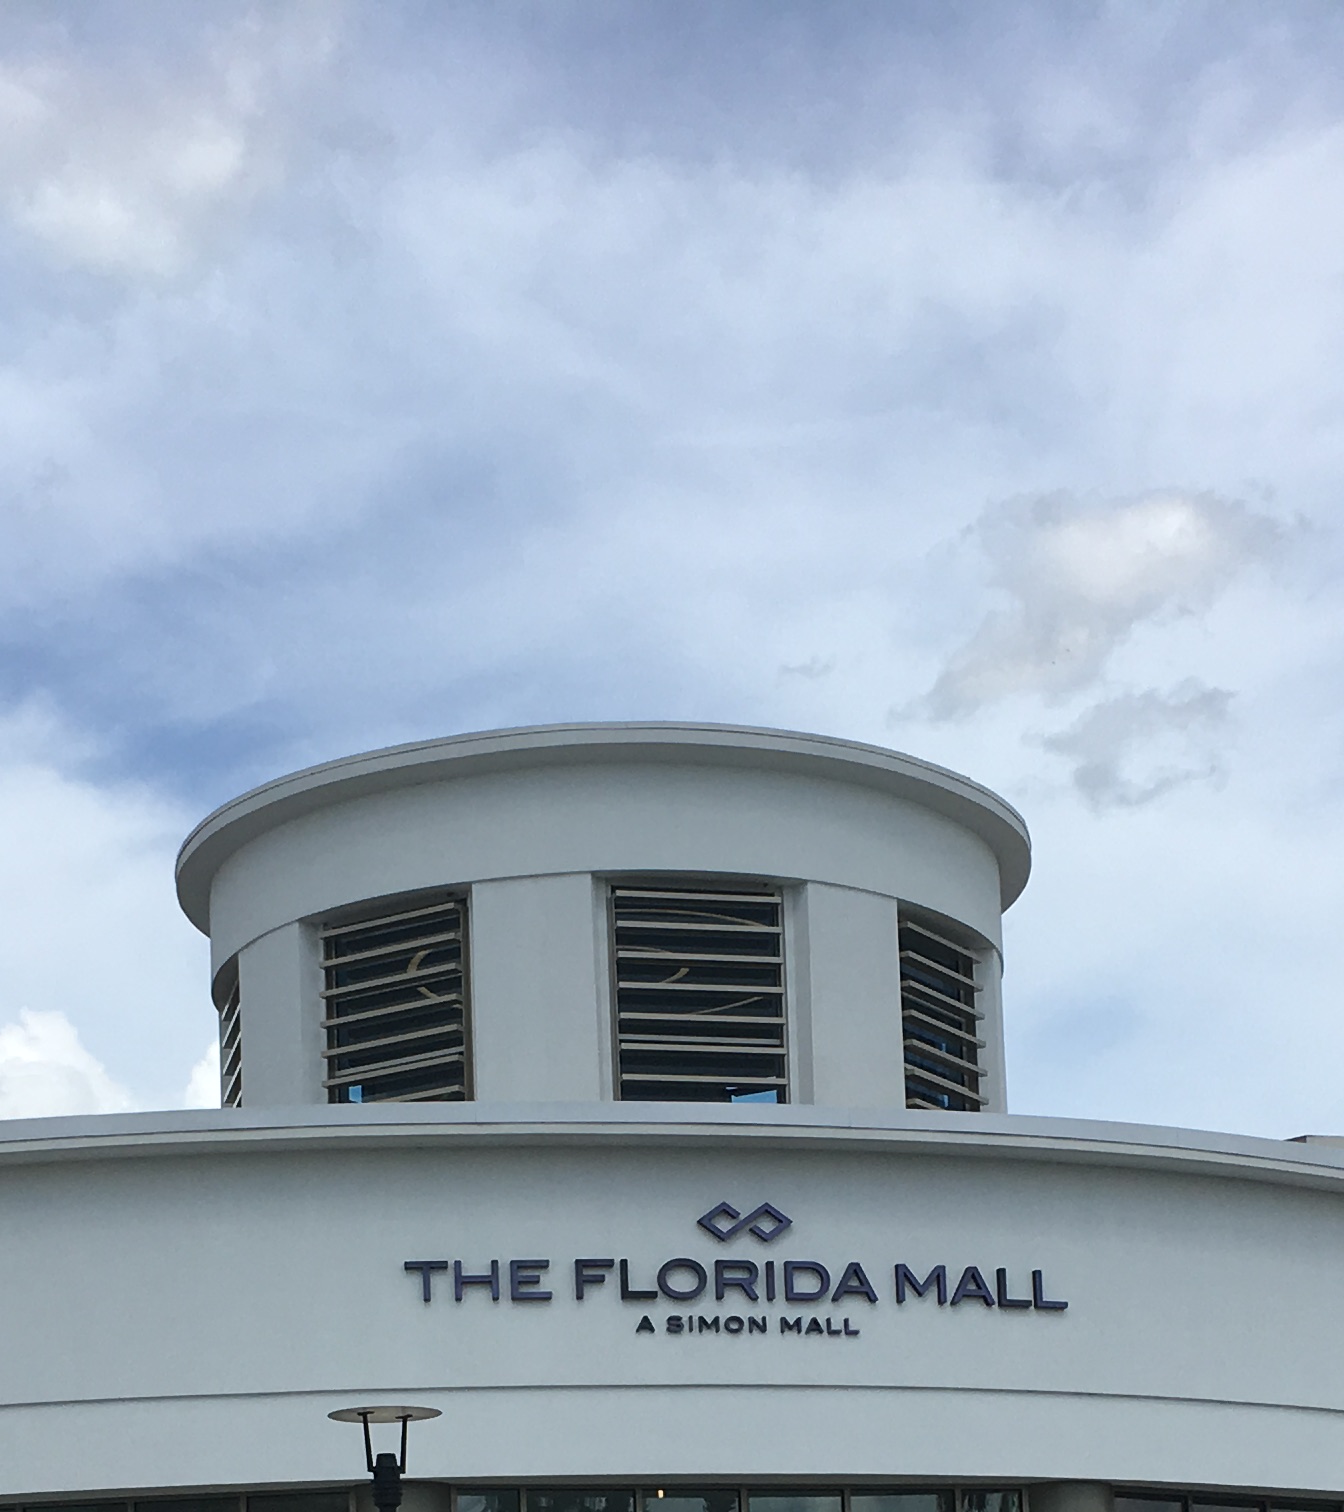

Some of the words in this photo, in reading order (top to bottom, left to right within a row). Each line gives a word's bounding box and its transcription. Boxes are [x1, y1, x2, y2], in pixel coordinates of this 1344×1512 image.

[404, 1258, 553, 1303] THE
[574, 1257, 879, 1304] FLORIDA
[895, 1263, 1068, 1310] MALL
[635, 1315, 656, 1334] A
[665, 1315, 768, 1335] SIMON
[780, 1316, 860, 1336] MALL
